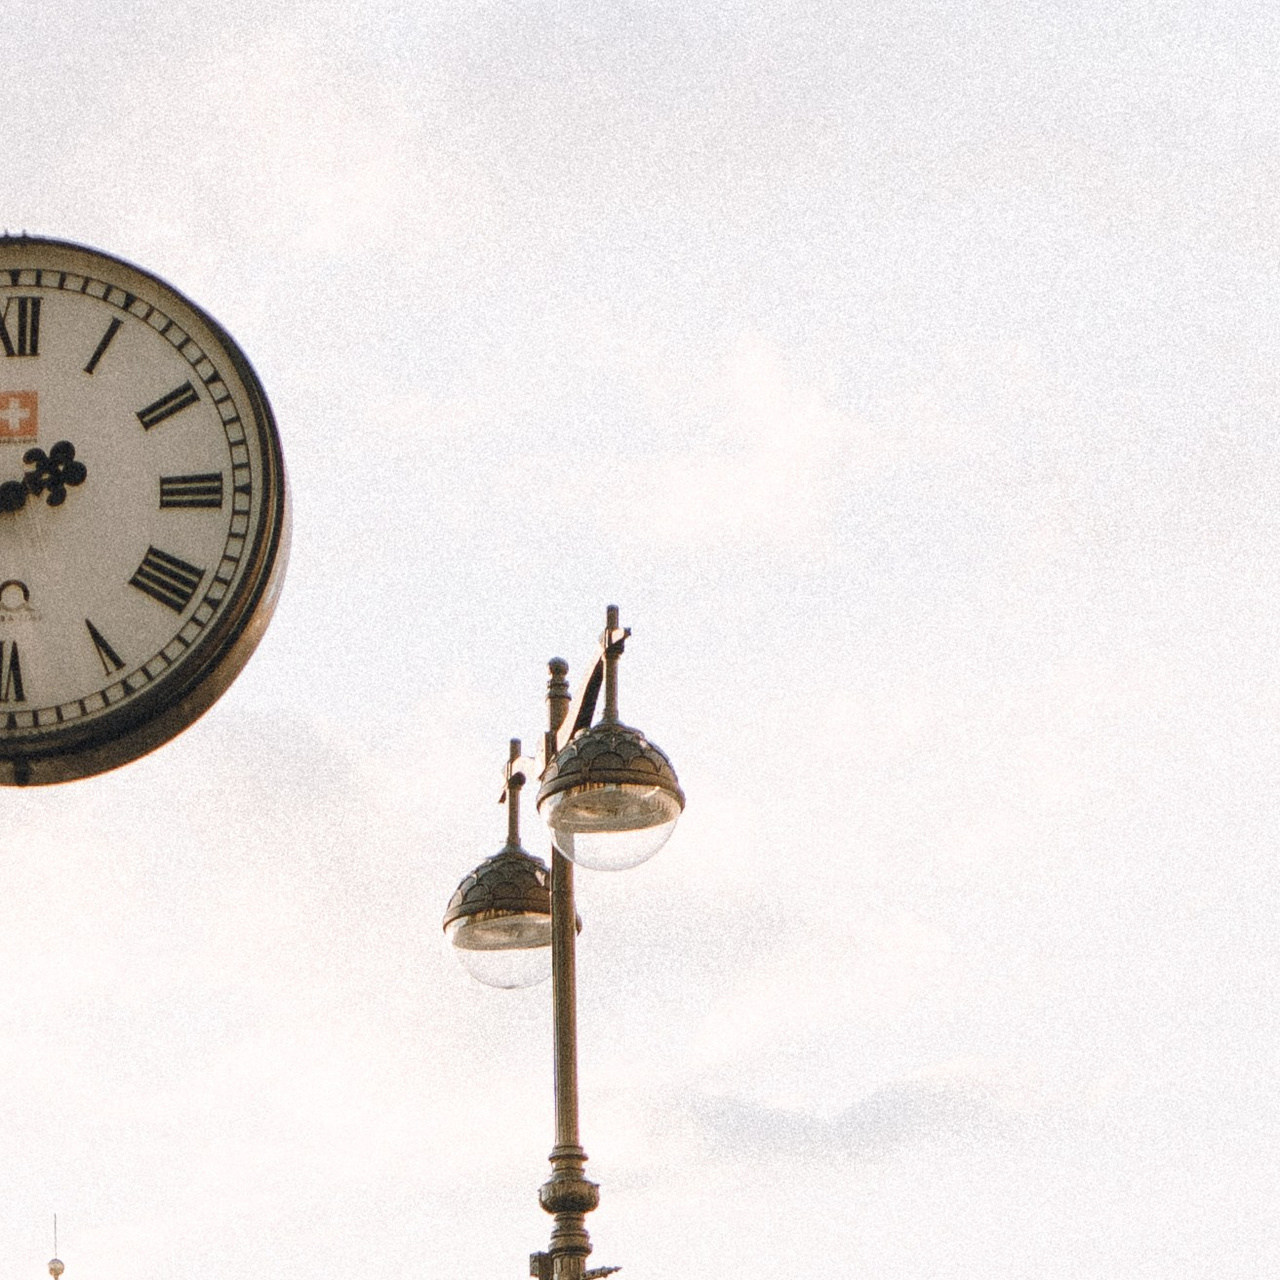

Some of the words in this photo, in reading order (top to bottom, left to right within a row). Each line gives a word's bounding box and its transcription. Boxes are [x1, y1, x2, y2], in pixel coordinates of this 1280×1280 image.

[84, 316, 123, 374] I
[136, 379, 202, 430] II
[159, 472, 223, 509] III
[85, 618, 126, 676] V
